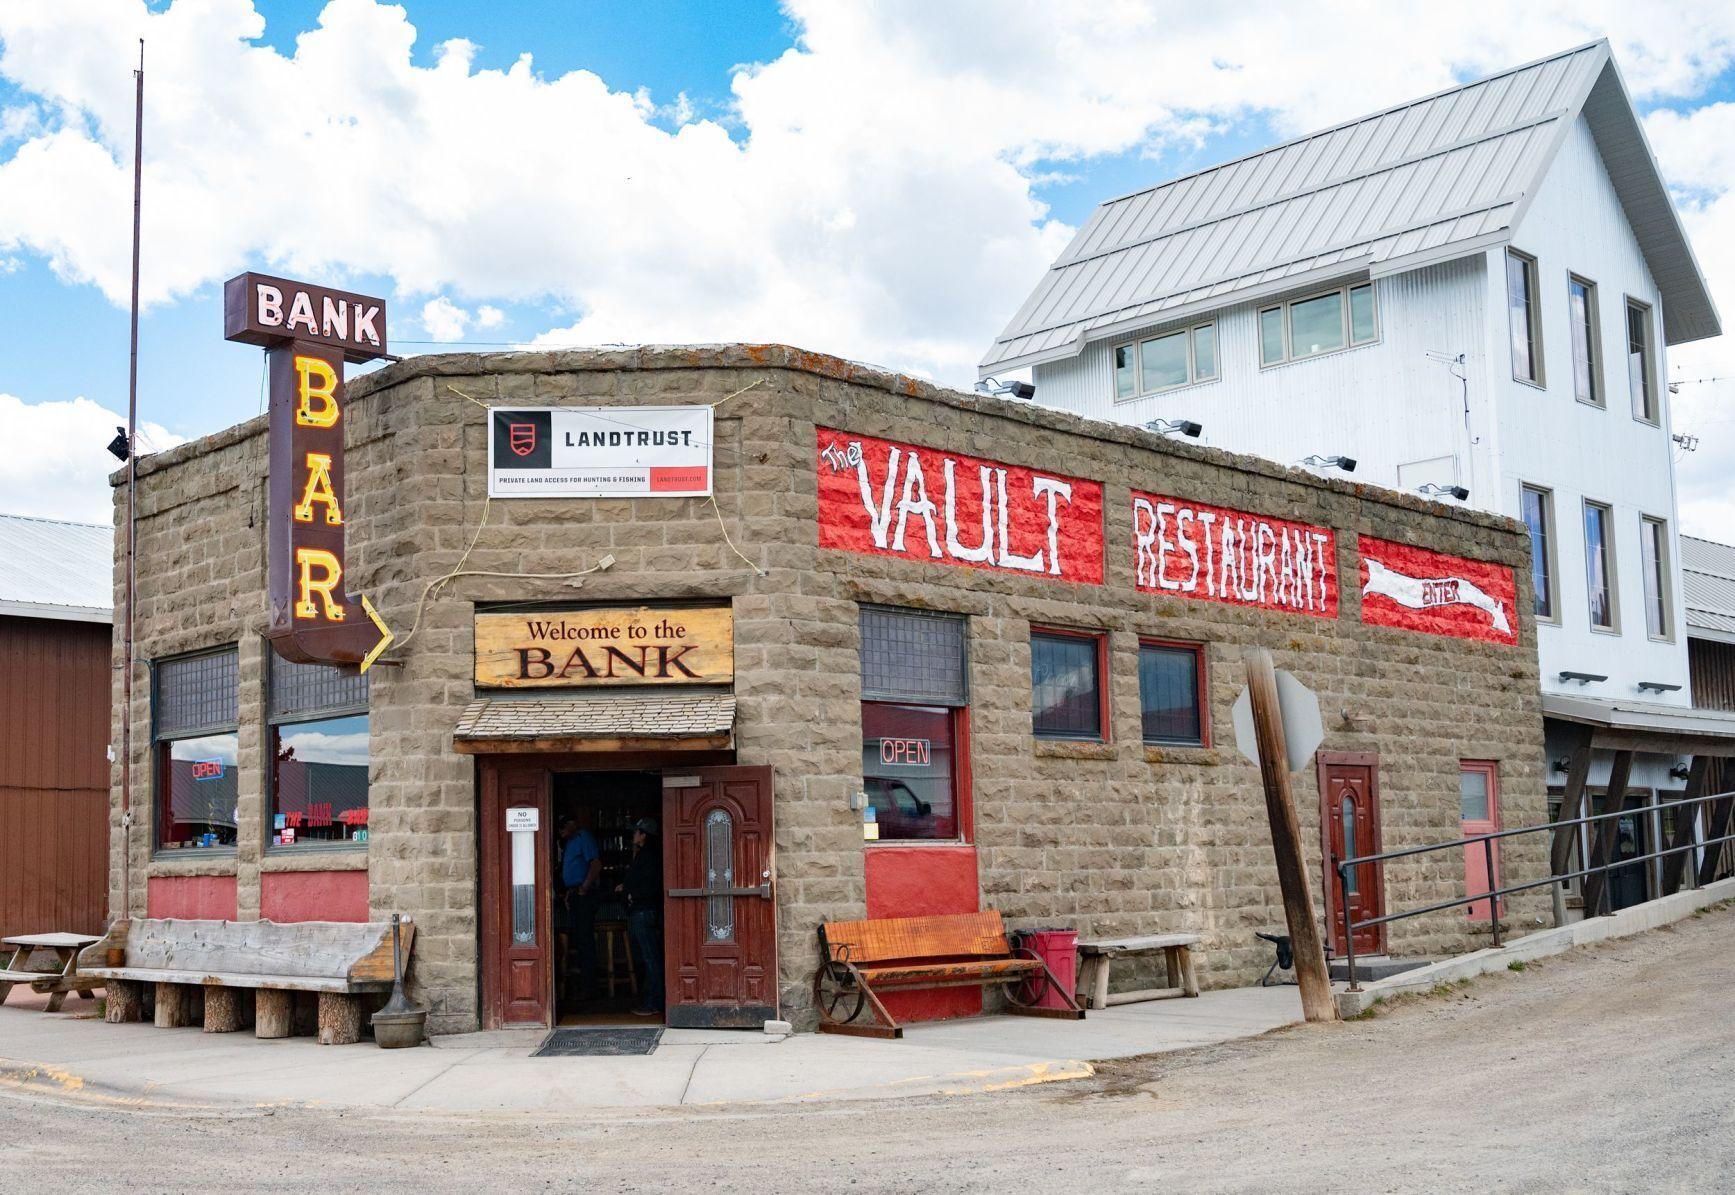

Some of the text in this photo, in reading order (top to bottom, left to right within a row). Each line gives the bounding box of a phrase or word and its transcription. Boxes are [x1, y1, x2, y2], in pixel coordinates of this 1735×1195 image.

[256, 283, 382, 347] BANK
[565, 430, 692, 447] LANDTRUST
[294, 356, 346, 621] BAR
[821, 442, 1073, 575] The VAULT
[1133, 497, 1328, 612] RESTAURANT
[1422, 580, 1461, 605] ENTER
[526, 619, 686, 641] Welcome to the
[513, 645, 703, 680] BANK
[882, 740, 929, 764] OPEN
[191, 761, 221, 778] OPEN
